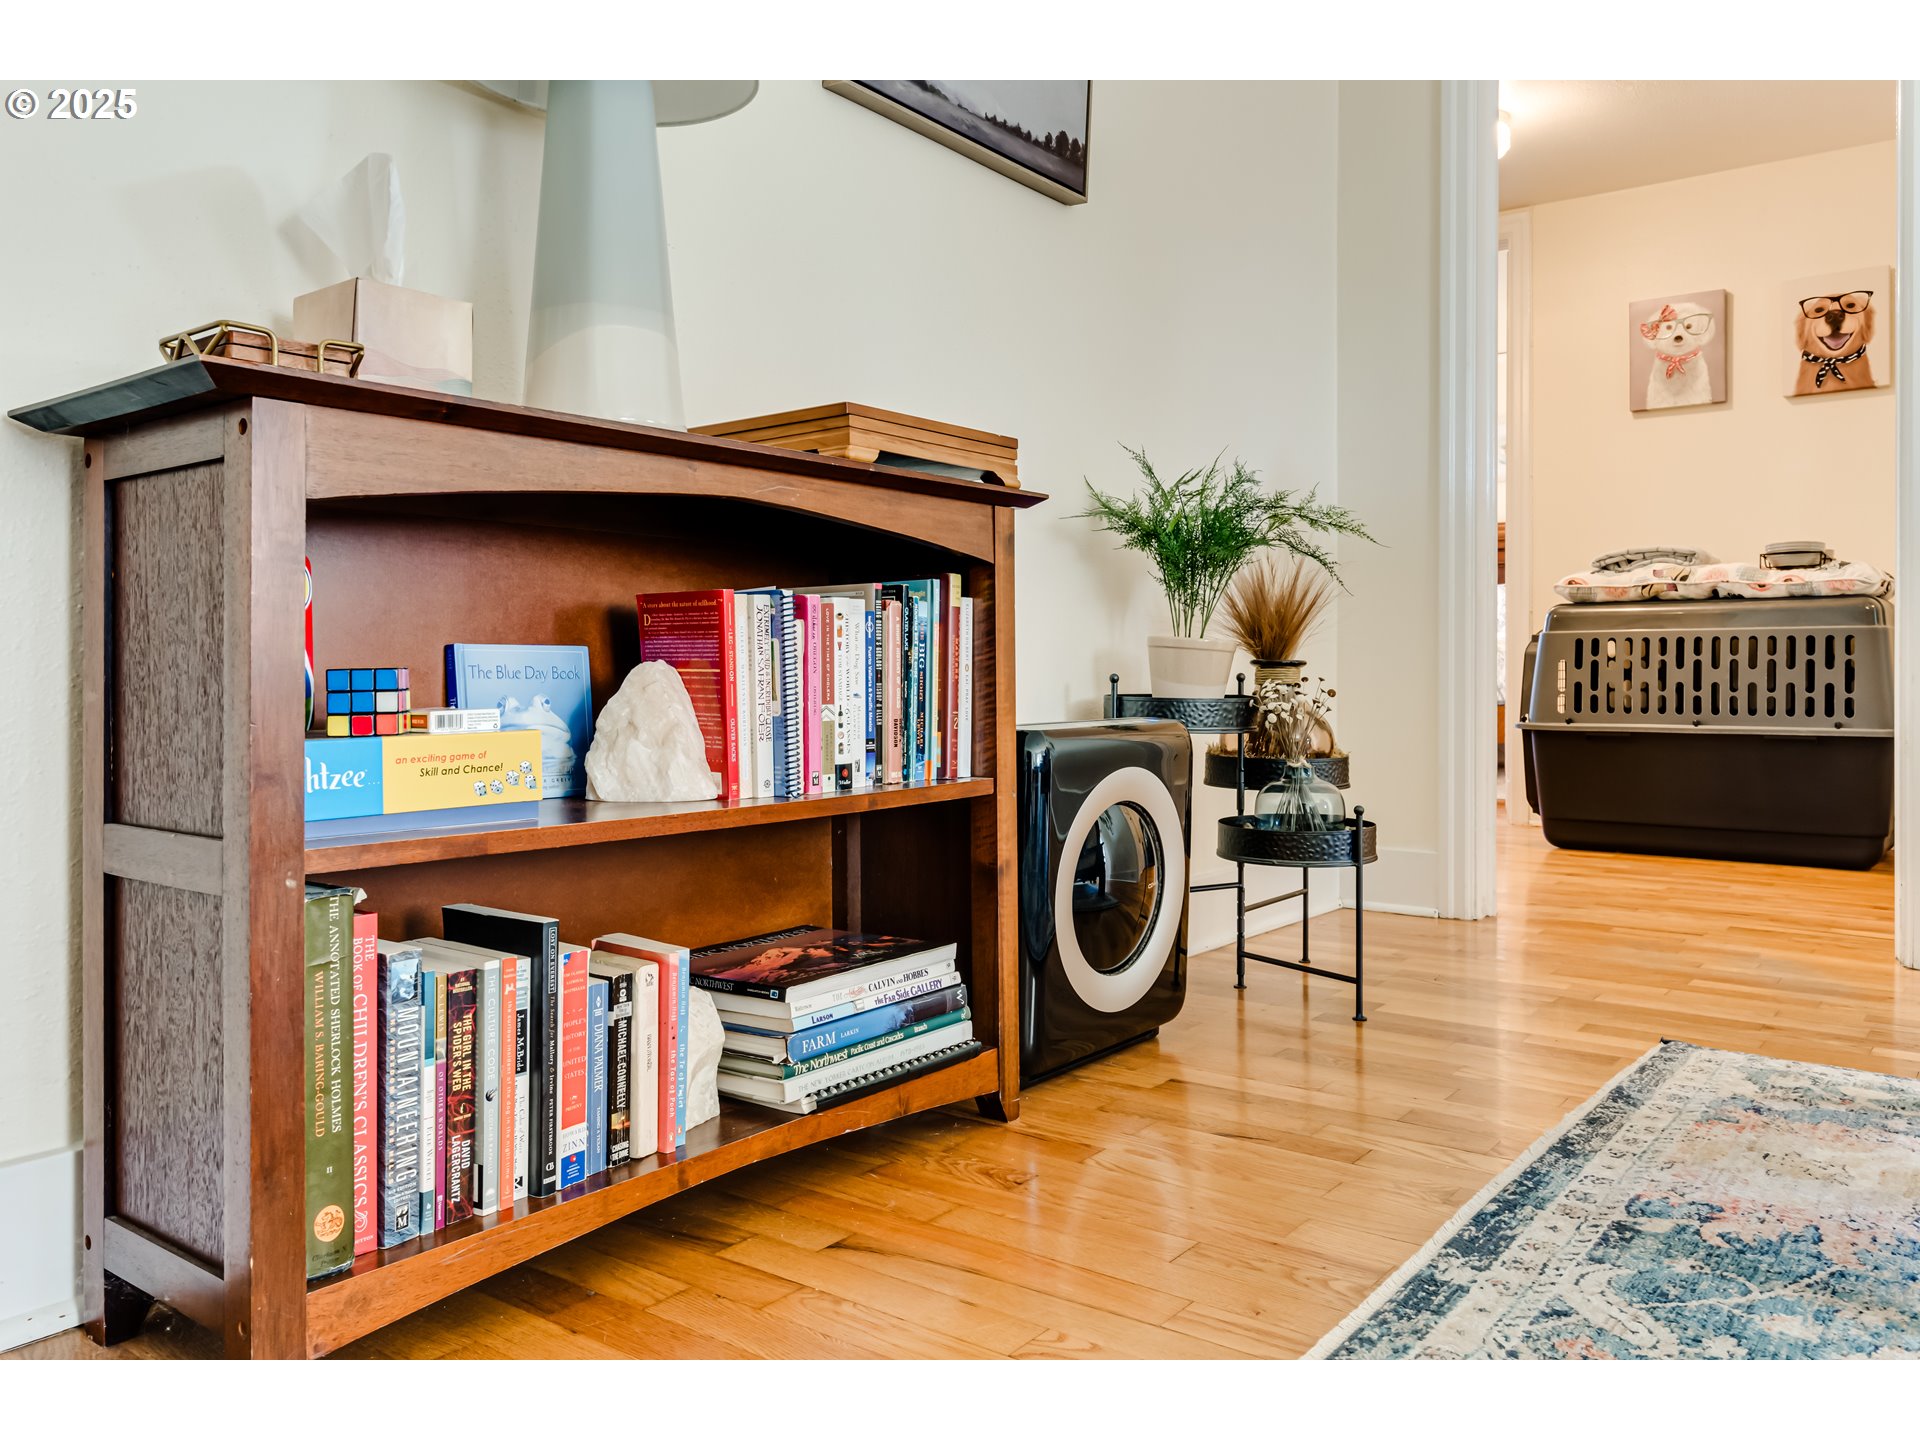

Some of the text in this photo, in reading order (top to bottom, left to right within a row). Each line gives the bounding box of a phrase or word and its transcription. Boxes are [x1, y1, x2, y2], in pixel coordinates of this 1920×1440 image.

[467, 664, 581, 684] The Blue Day Book
[729, 670, 735, 682] ON
[756, 605, 765, 742] JONATHAN SAFRAN FOER
[826, 663, 830, 672] OF
[395, 751, 488, 765] an exciting game of
[419, 763, 504, 778] Skill and Chance!
[365, 934, 375, 962] THE
[550, 948, 556, 960] ON
[721, 928, 811, 954] NORTHWEST
[487, 974, 496, 993] THE
[868, 978, 896, 992] CALVIN
[903, 968, 929, 982] HOBBES
[329, 894, 342, 1133] THE ANNOTATED SHERLOCK HOLMES
[811, 1013, 834, 1024] LARSON
[883, 993, 896, 1004] FAR
[910, 978, 943, 996] GALLERY
[487, 1001, 496, 1042] CULTURE
[516, 1013, 525, 1036] James
[594, 1023, 604, 1053] DIANA
[617, 1019, 627, 1059] MICHAEL
[802, 1027, 859, 1054] FARM LARKIN
[314, 970, 325, 1138] WILLIAM S. BARING-GOULD
[452, 1021, 462, 1092] SPIDER'S WEB
[462, 1013, 473, 1092] THE GIRL IN THE
[487, 1048, 496, 1081] CODE
[516, 1037, 525, 1072] McBride
[562, 1055, 587, 1068] UNITED
[793, 1062, 809, 1076] The
[809, 1048, 848, 1071] Northwest
[850, 1043, 864, 1055] Pacific
[863, 1040, 876, 1053] Coast
[876, 1036, 885, 1047] and
[353, 937, 368, 1208] BOOK OF CHILDREN'S CLASSICS
[506, 1076, 513, 1085] of
[563, 1069, 586, 1081] STATES
[594, 1055, 603, 1093] PALMER
[616, 1063, 627, 1109] CONNELLY
[678, 1072, 684, 1081] of
[396, 1005, 419, 1183] MOUNTAINEERING
[669, 1085, 676, 1093] of
[505, 1100, 513, 1115] dog
[506, 1116, 512, 1124] in
[461, 1139, 471, 1169] DAVID
[562, 1137, 586, 1153] ZINN
[451, 1134, 461, 1204] LAGERCRANTZ
